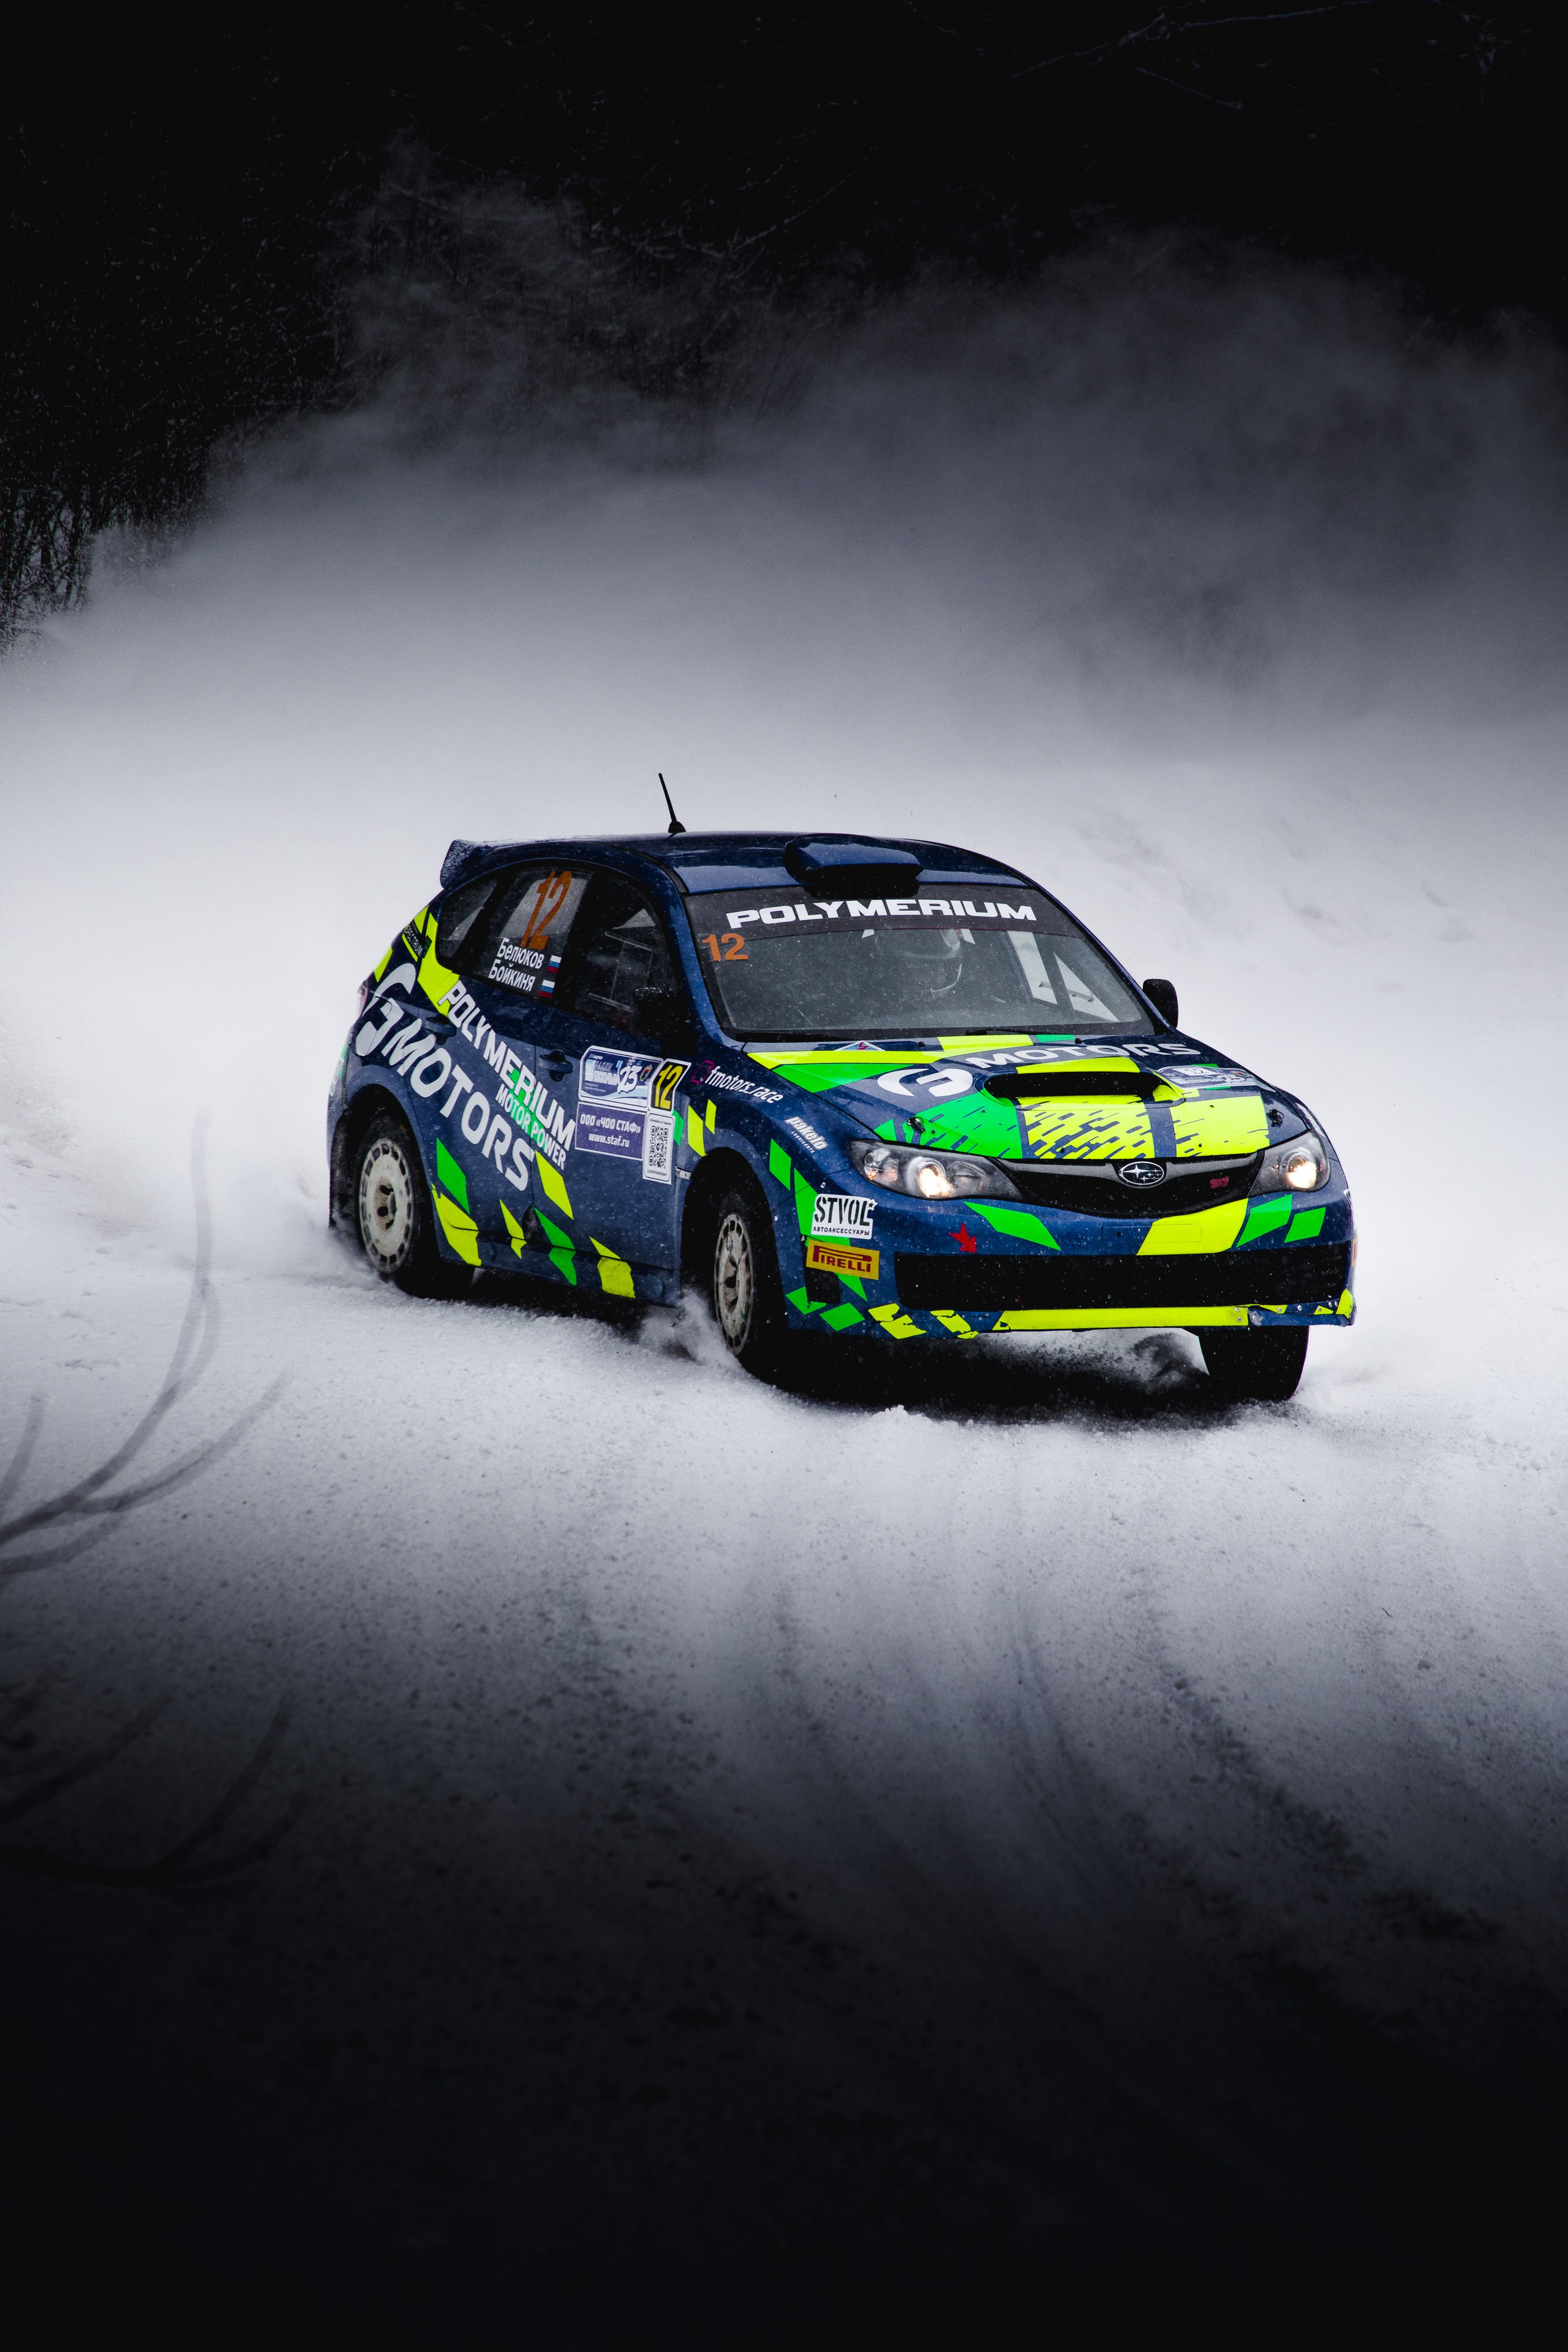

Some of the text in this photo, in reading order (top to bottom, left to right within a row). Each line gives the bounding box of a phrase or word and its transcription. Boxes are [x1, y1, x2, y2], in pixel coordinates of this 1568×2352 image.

[520, 870, 572, 949] 12
[726, 899, 1037, 929] POLYMERIUM
[497, 938, 545, 969] Белюков
[703, 933, 748, 962] 12
[488, 959, 535, 992] Бойкиня
[437, 980, 576, 1152] POLYMERIUM
[965, 1043, 1201, 1069] MOTORS
[654, 1065, 683, 1109] 12
[495, 1084, 567, 1170] MOTOR POWER
[579, 1114, 596, 1126] ООО
[785, 1116, 827, 1150] pakelo
[589, 1133, 630, 1148] www.staf.ru
[791, 1131, 815, 1153] LUBRICANTS
[814, 1196, 870, 1227] STVOL
[813, 1226, 870, 1236] АВТОАКСЕССУАРЫ
[812, 1245, 872, 1273] PIRELLI
